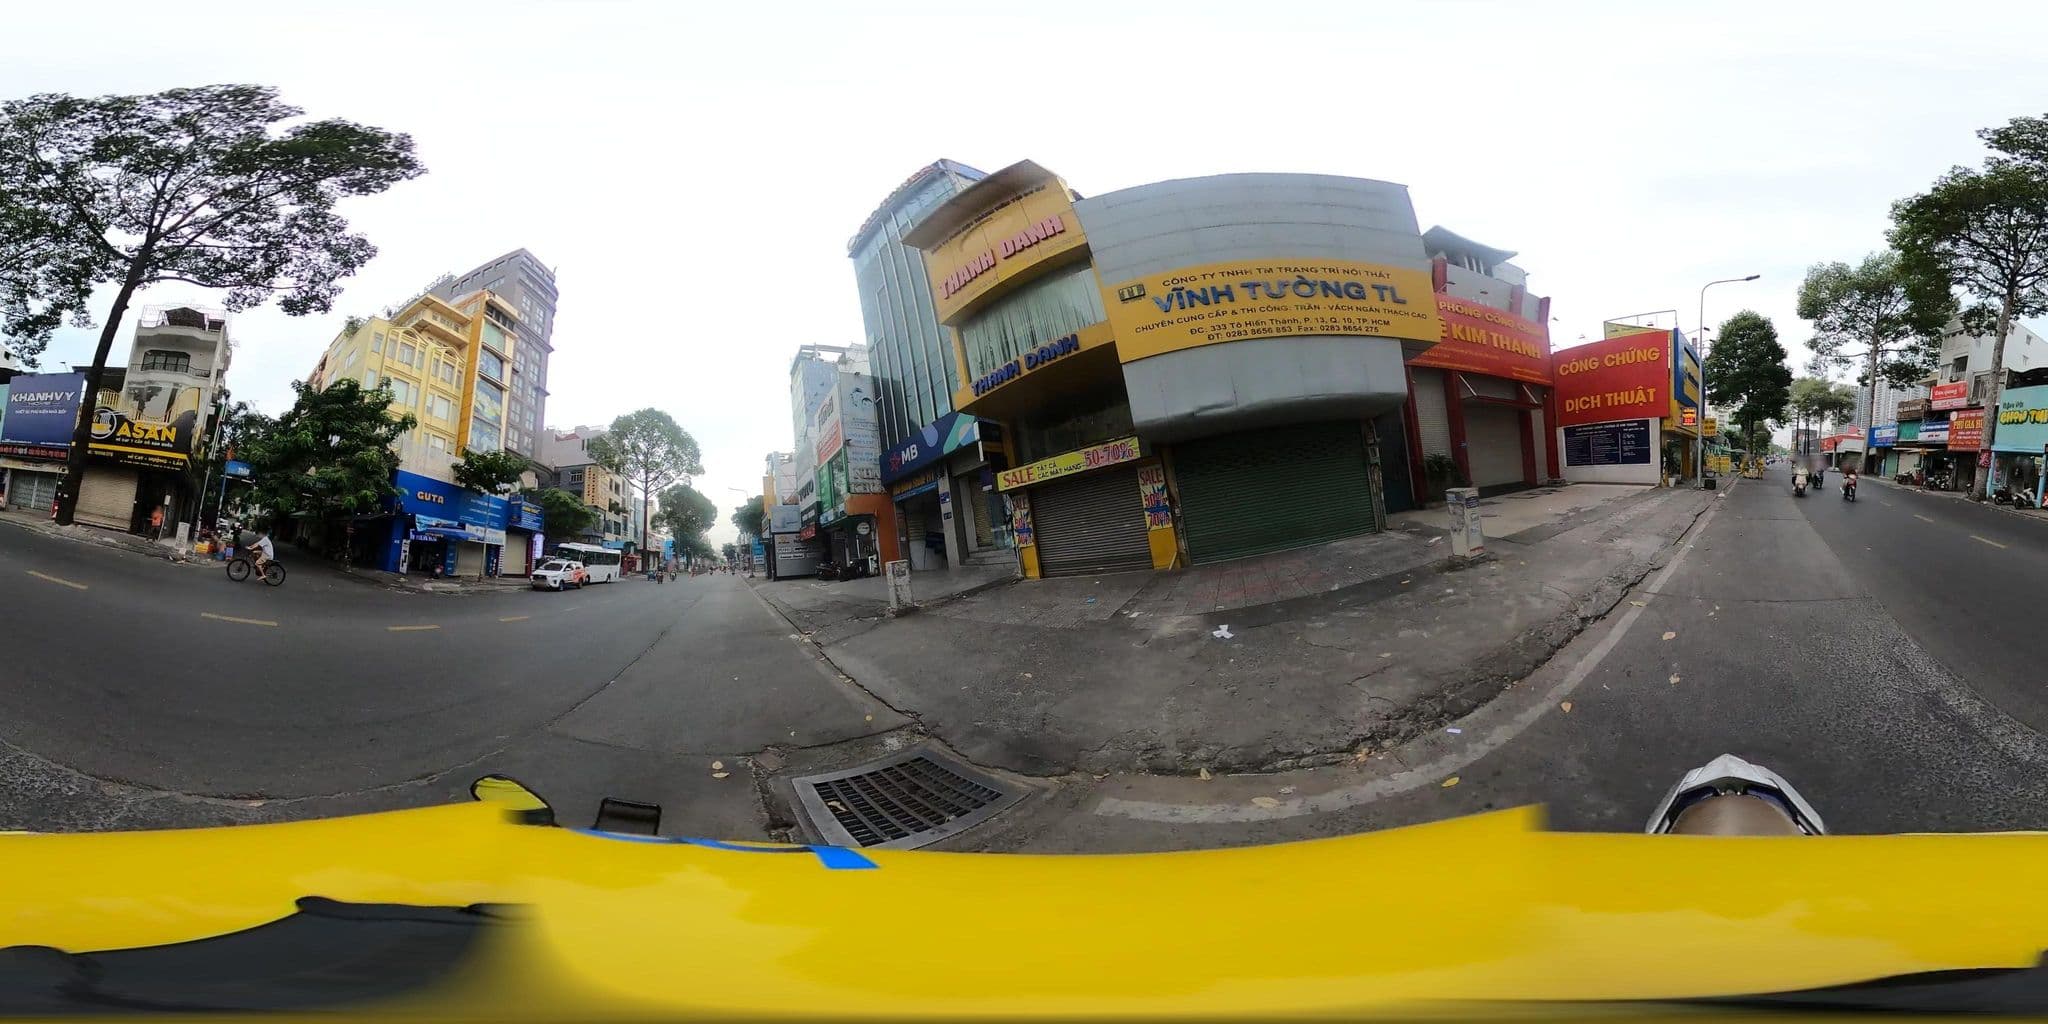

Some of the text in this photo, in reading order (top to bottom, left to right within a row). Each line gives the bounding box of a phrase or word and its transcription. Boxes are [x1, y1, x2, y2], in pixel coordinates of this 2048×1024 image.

[939, 249, 997, 300] THANH
[999, 215, 1066, 260] DANH
[1162, 273, 1198, 287] CÔNG
[1202, 272, 1215, 280] TY
[1219, 269, 1252, 278] TNHH
[1277, 266, 1318, 274] TRANG
[1152, 283, 1235, 313] VĨNH
[1240, 275, 1367, 301] TƯỜNG
[1371, 283, 1407, 305] TL
[1176, 314, 1206, 325] CUNG
[1240, 307, 1257, 315] THI
[1210, 323, 1227, 332] 333
[1370, 318, 1391, 326] HCM
[1451, 323, 1488, 345] KIM
[971, 333, 1080, 398] THANH DANH
[1558, 358, 1600, 376] CÔNG
[1603, 346, 1662, 367] CHỨNG
[1565, 385, 1657, 414] DỊCH THUẬT
[901, 444, 918, 464] MB
[1003, 467, 1034, 488] SALE
[1140, 467, 1163, 486] SALE
[416, 491, 444, 505] GUTA
